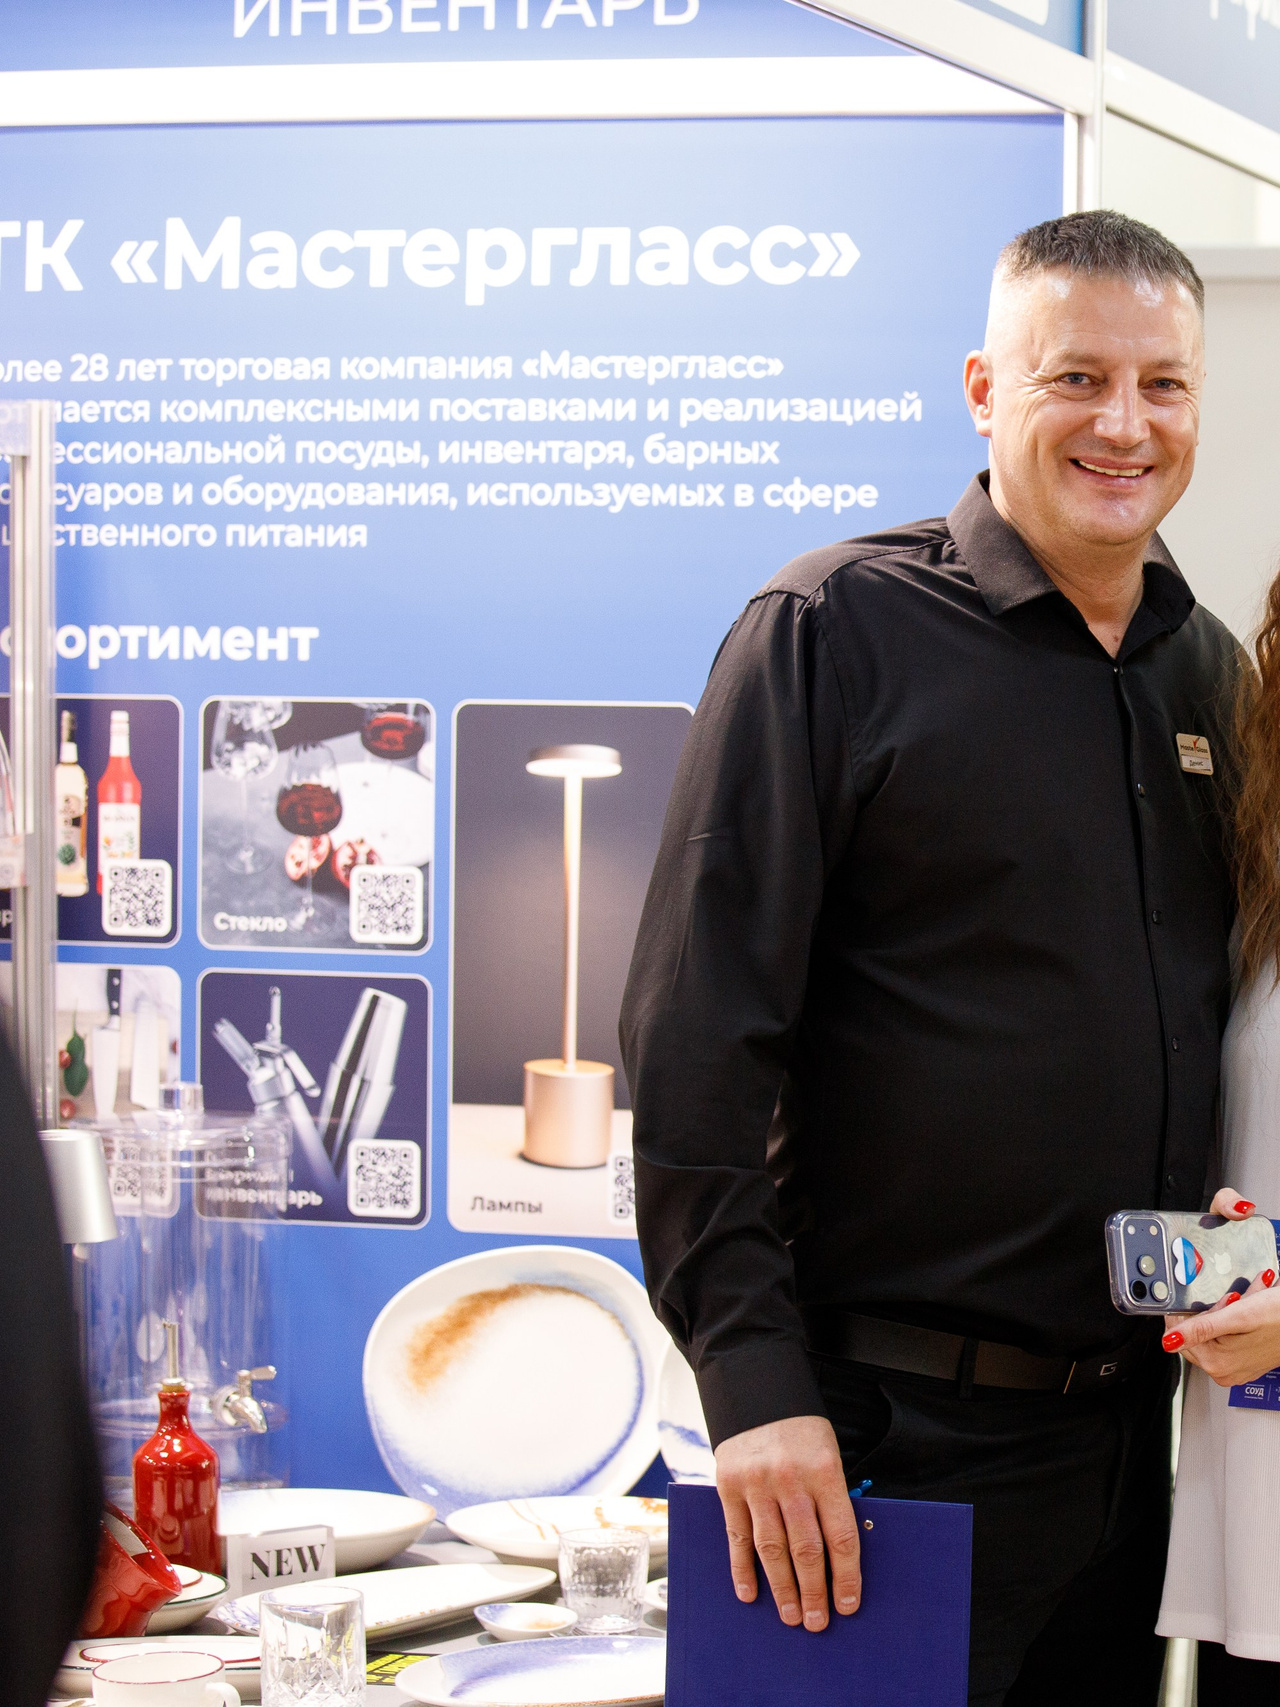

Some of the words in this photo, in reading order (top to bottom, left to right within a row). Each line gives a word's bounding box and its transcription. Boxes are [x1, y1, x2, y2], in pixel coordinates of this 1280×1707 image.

[234, 0, 700, 38] ИНВЕНТАРЬ
[109, 216, 861, 307] «Мастергласс»
[0, 359, 63, 383] лее
[70, 353, 109, 382] 28
[116, 358, 174, 382] лет
[179, 357, 331, 388] торговая
[341, 356, 513, 380] компания
[522, 350, 785, 386] «Мастергласс»
[160, 399, 420, 423] комплексными
[429, 398, 637, 422] поставками
[647, 399, 670, 422] и
[679, 392, 923, 429] реализацией
[50, 433, 286, 465] ессиональной
[296, 441, 430, 471] посуды,
[439, 440, 635, 471] инвентаря,
[644, 434, 780, 464] барных
[50, 482, 164, 512] суаров
[173, 483, 193, 506] и
[202, 474, 458, 512] оборудования,
[467, 483, 725, 513] используемых
[735, 484, 755, 507] в
[763, 477, 879, 515] сфере
[50, 524, 217, 548] ственного
[226, 523, 368, 548] питания
[48, 624, 320, 670] ортимент
[213, 911, 288, 933] Стекло
[471, 1195, 543, 1214] Лампы
[1245, 1386, 1265, 1397] СОУД
[250, 1543, 326, 1580] NEW
